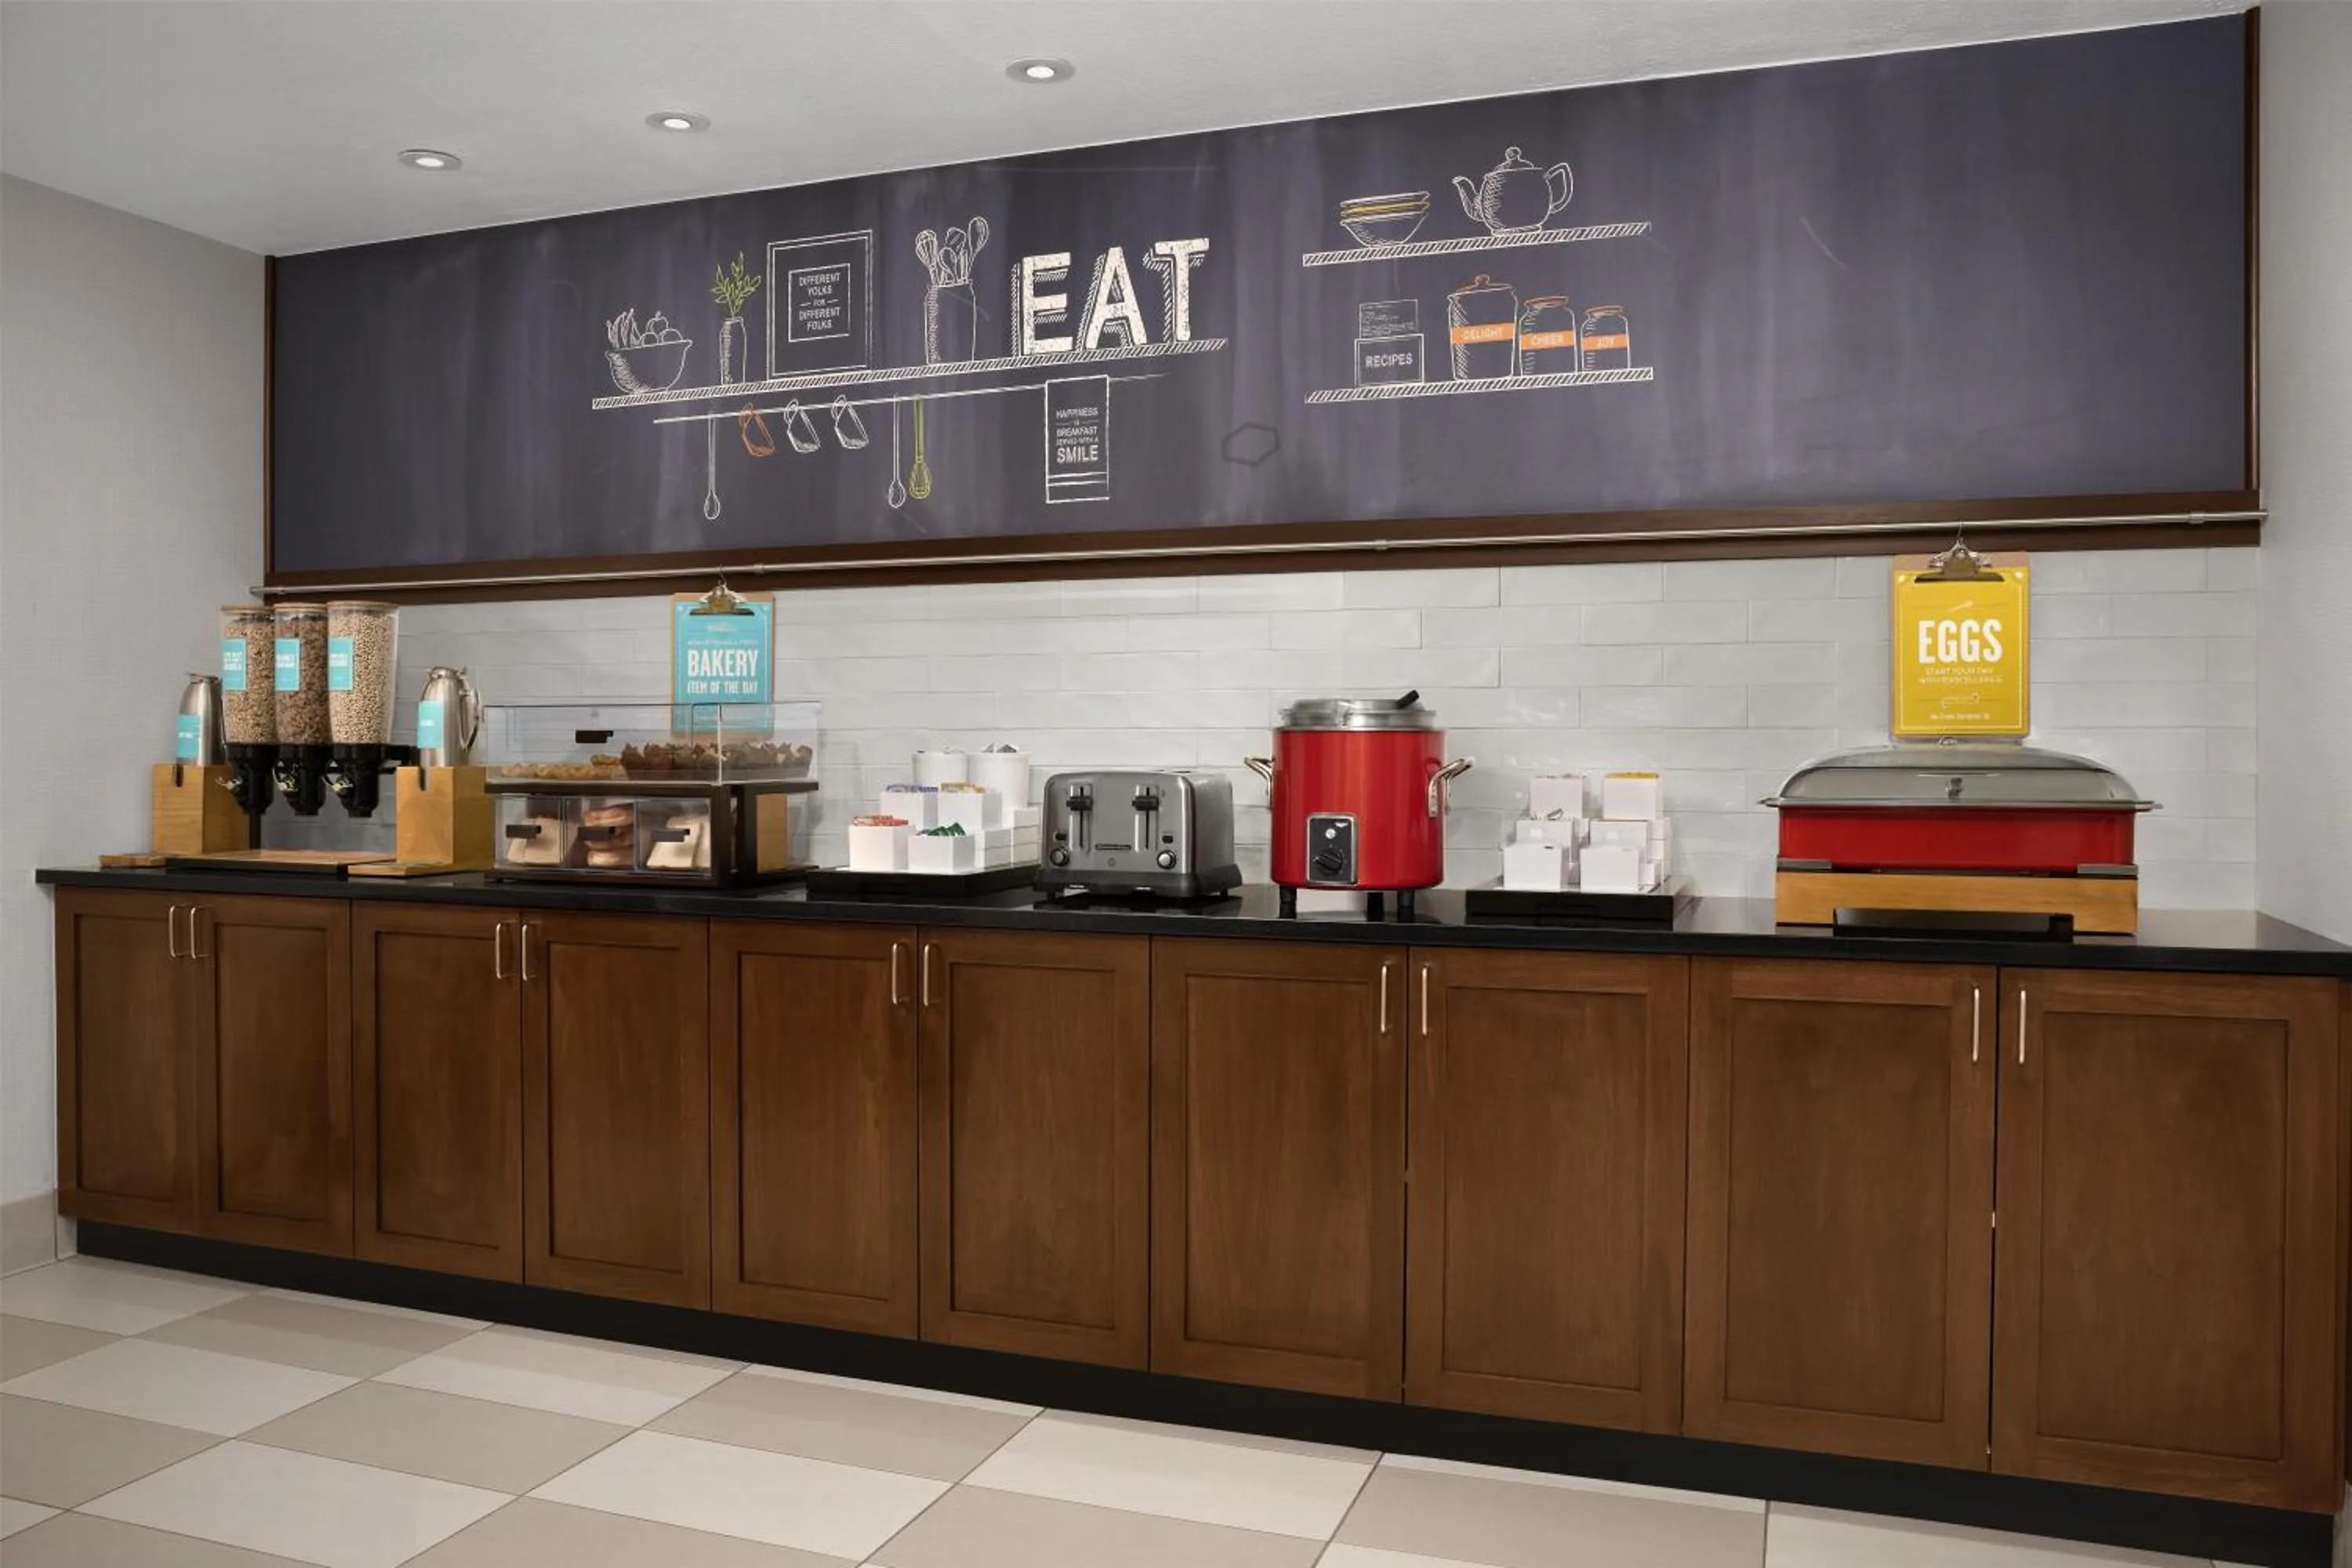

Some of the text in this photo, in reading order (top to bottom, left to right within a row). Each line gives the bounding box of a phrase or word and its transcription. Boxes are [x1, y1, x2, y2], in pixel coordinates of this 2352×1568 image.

[799, 272, 840, 286] DIFFERENT
[807, 285, 832, 296] YOLKS
[1011, 238, 1210, 357] EAT
[799, 307, 840, 321] DIFFERENT
[807, 319, 832, 331] FOLKS
[1463, 327, 1503, 340] DELIGHT
[1531, 335, 1565, 347] CHEER
[1597, 338, 1615, 349] JOY
[1365, 352, 1413, 369] RECIPES
[1056, 407, 1098, 419] HAPPINESS
[1056, 426, 1097, 437] BREAKFAST
[1056, 445, 1098, 464] SMILE
[1918, 618, 2004, 664] EGGS
[687, 648, 759, 677] BAKERY
[687, 680, 758, 695] ITEM OF THE DAY
